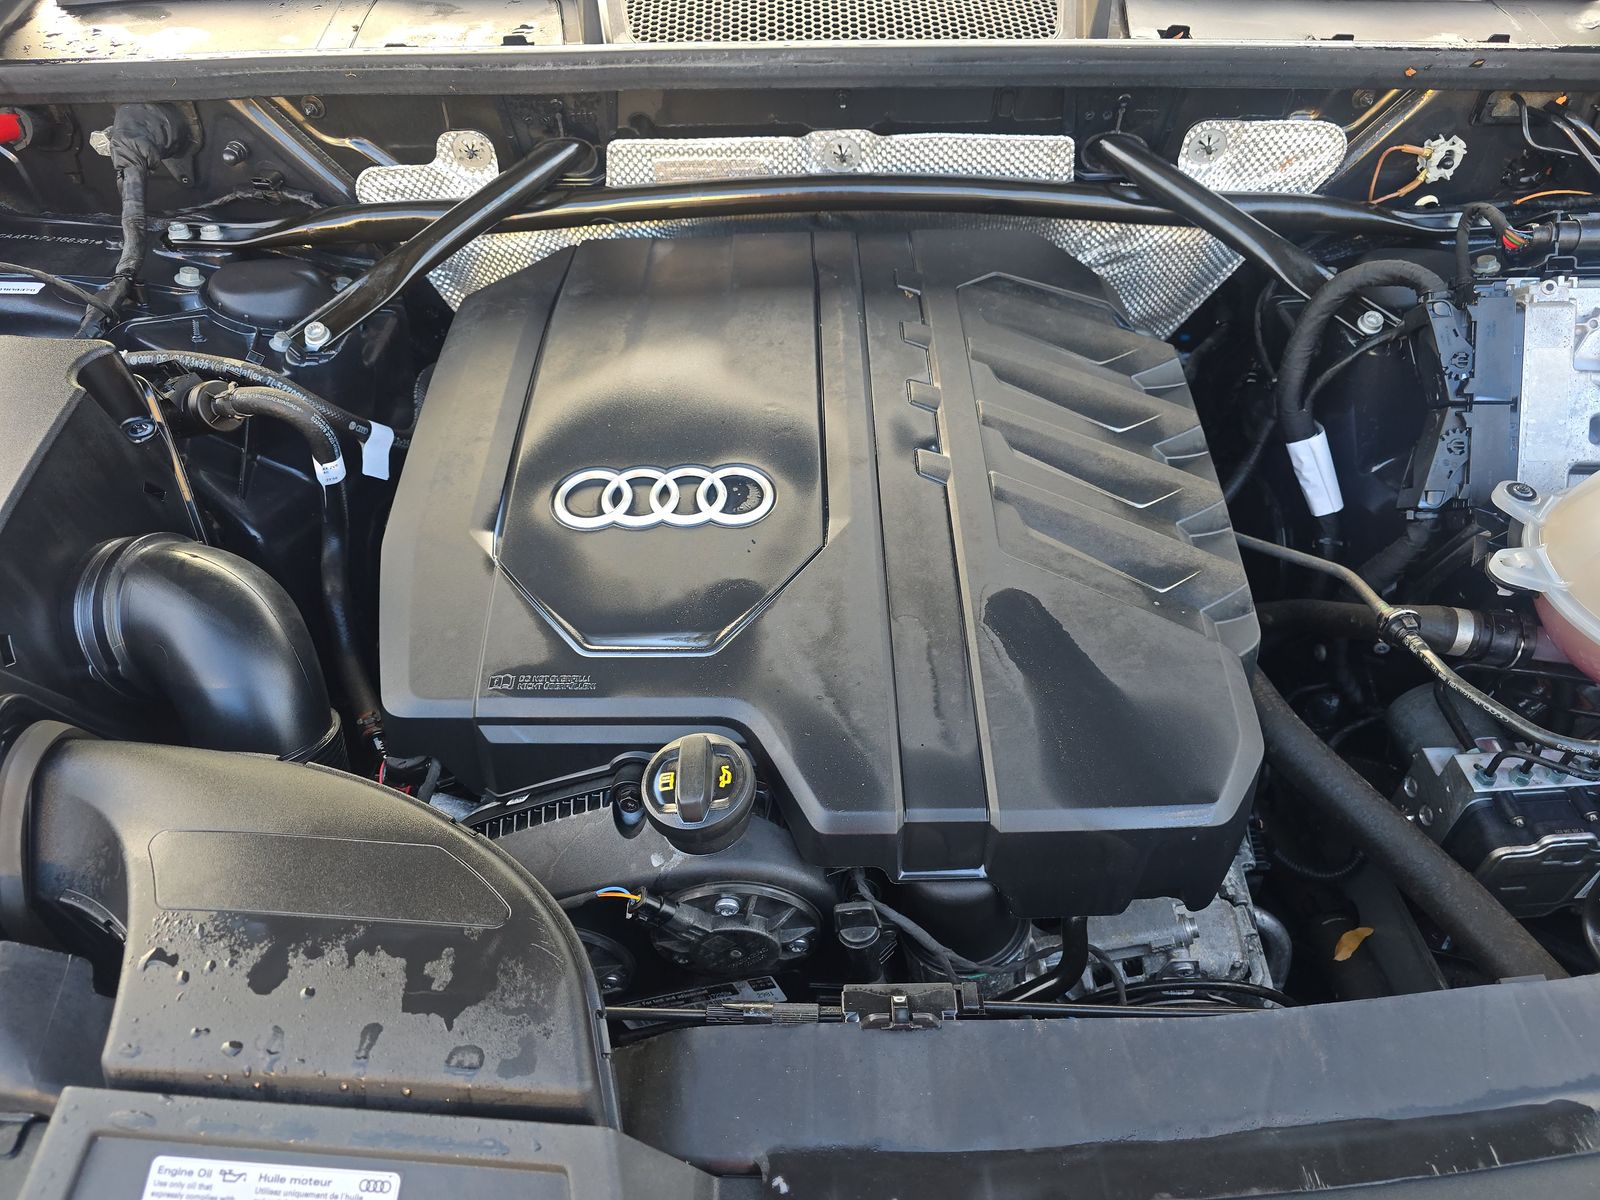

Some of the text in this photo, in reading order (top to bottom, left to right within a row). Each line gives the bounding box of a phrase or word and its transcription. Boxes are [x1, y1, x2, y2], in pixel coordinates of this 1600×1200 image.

[157, 1165, 213, 1178] Engine Oil
[153, 1179, 168, 1187] Use
[169, 1181, 185, 1190] only
[186, 1181, 197, 1189] oil
[258, 1172, 333, 1187] Huile moteur
[254, 1186, 282, 1197] Utilisez
[282, 1189, 328, 1199] uniquement
[329, 1192, 339, 1200] de
